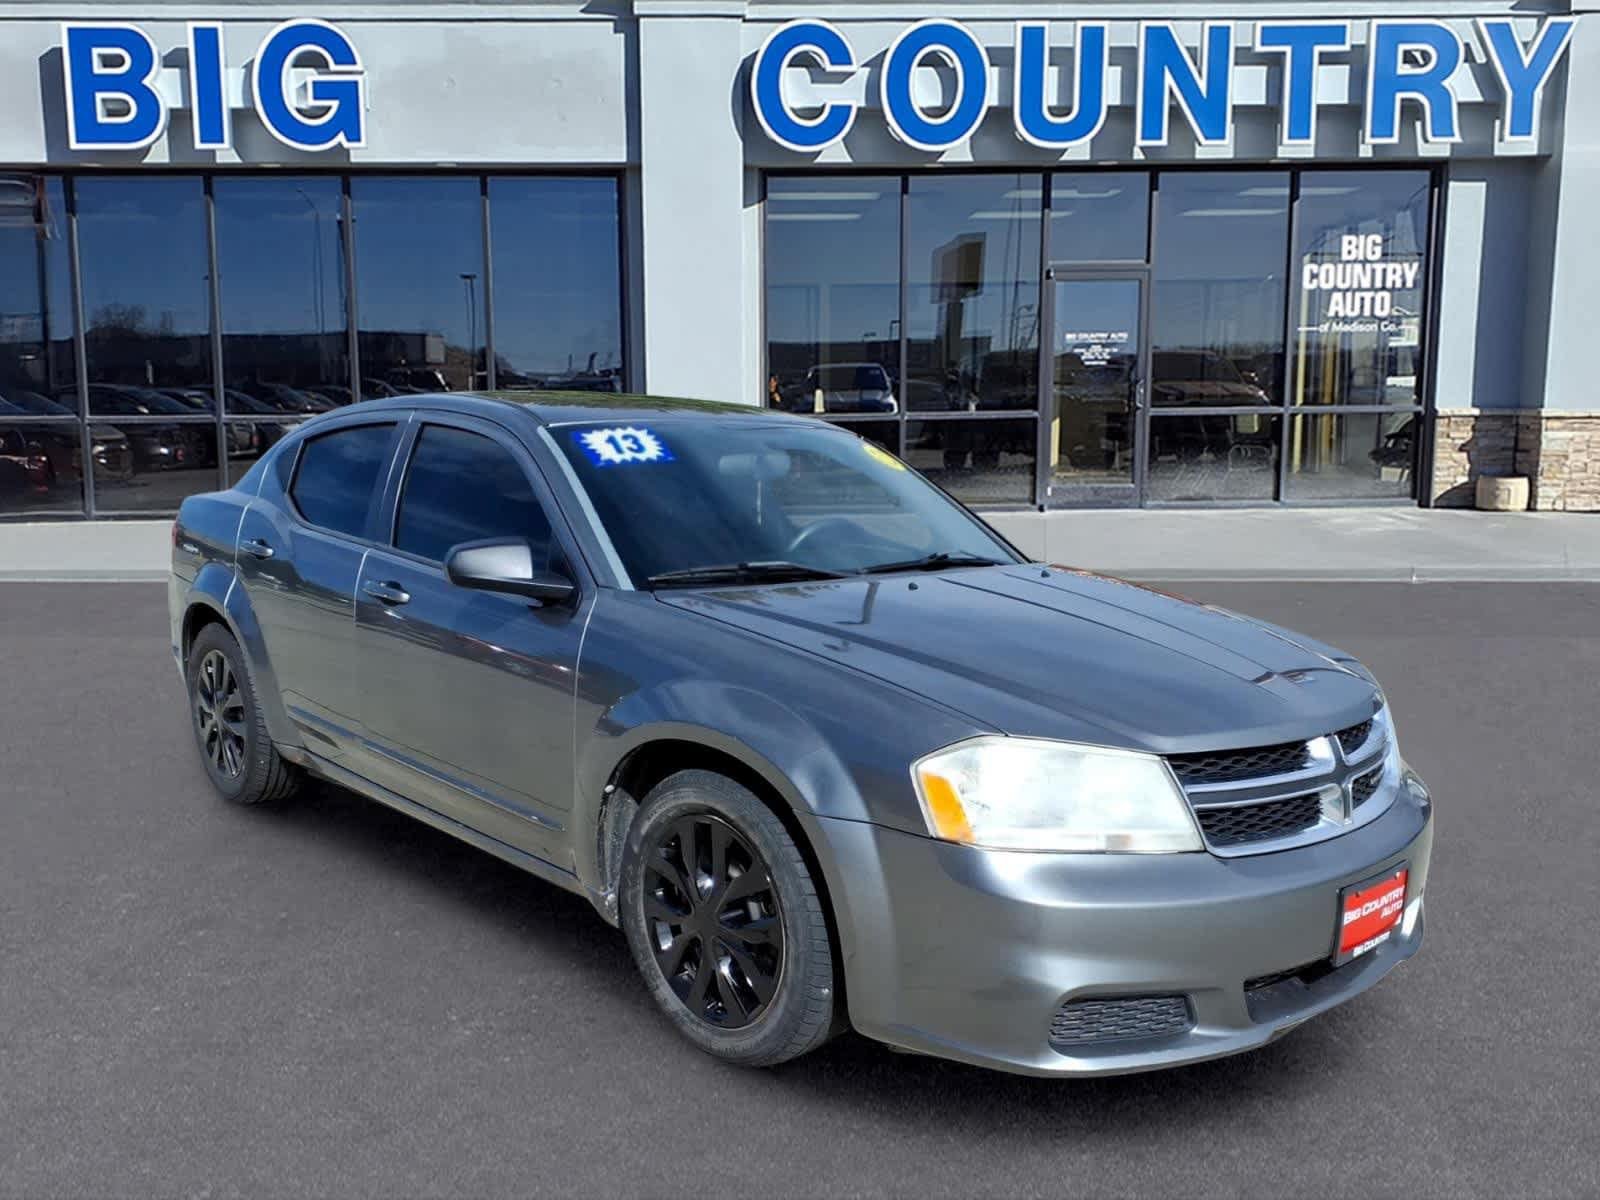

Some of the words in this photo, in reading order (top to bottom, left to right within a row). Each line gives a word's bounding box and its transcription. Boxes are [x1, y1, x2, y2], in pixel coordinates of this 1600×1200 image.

[61, 18, 367, 152] BIG
[751, 18, 1577, 153] COUNTRY
[1341, 233, 1383, 261] BIG
[1302, 262, 1420, 290] COUNTRY
[1327, 291, 1392, 318] AUTO
[1331, 321, 1379, 333] Madison
[604, 434, 646, 455] 13
[1343, 907, 1362, 926] BIG
[1362, 884, 1406, 917] COUNTRY
[1381, 899, 1404, 919] AUTO
